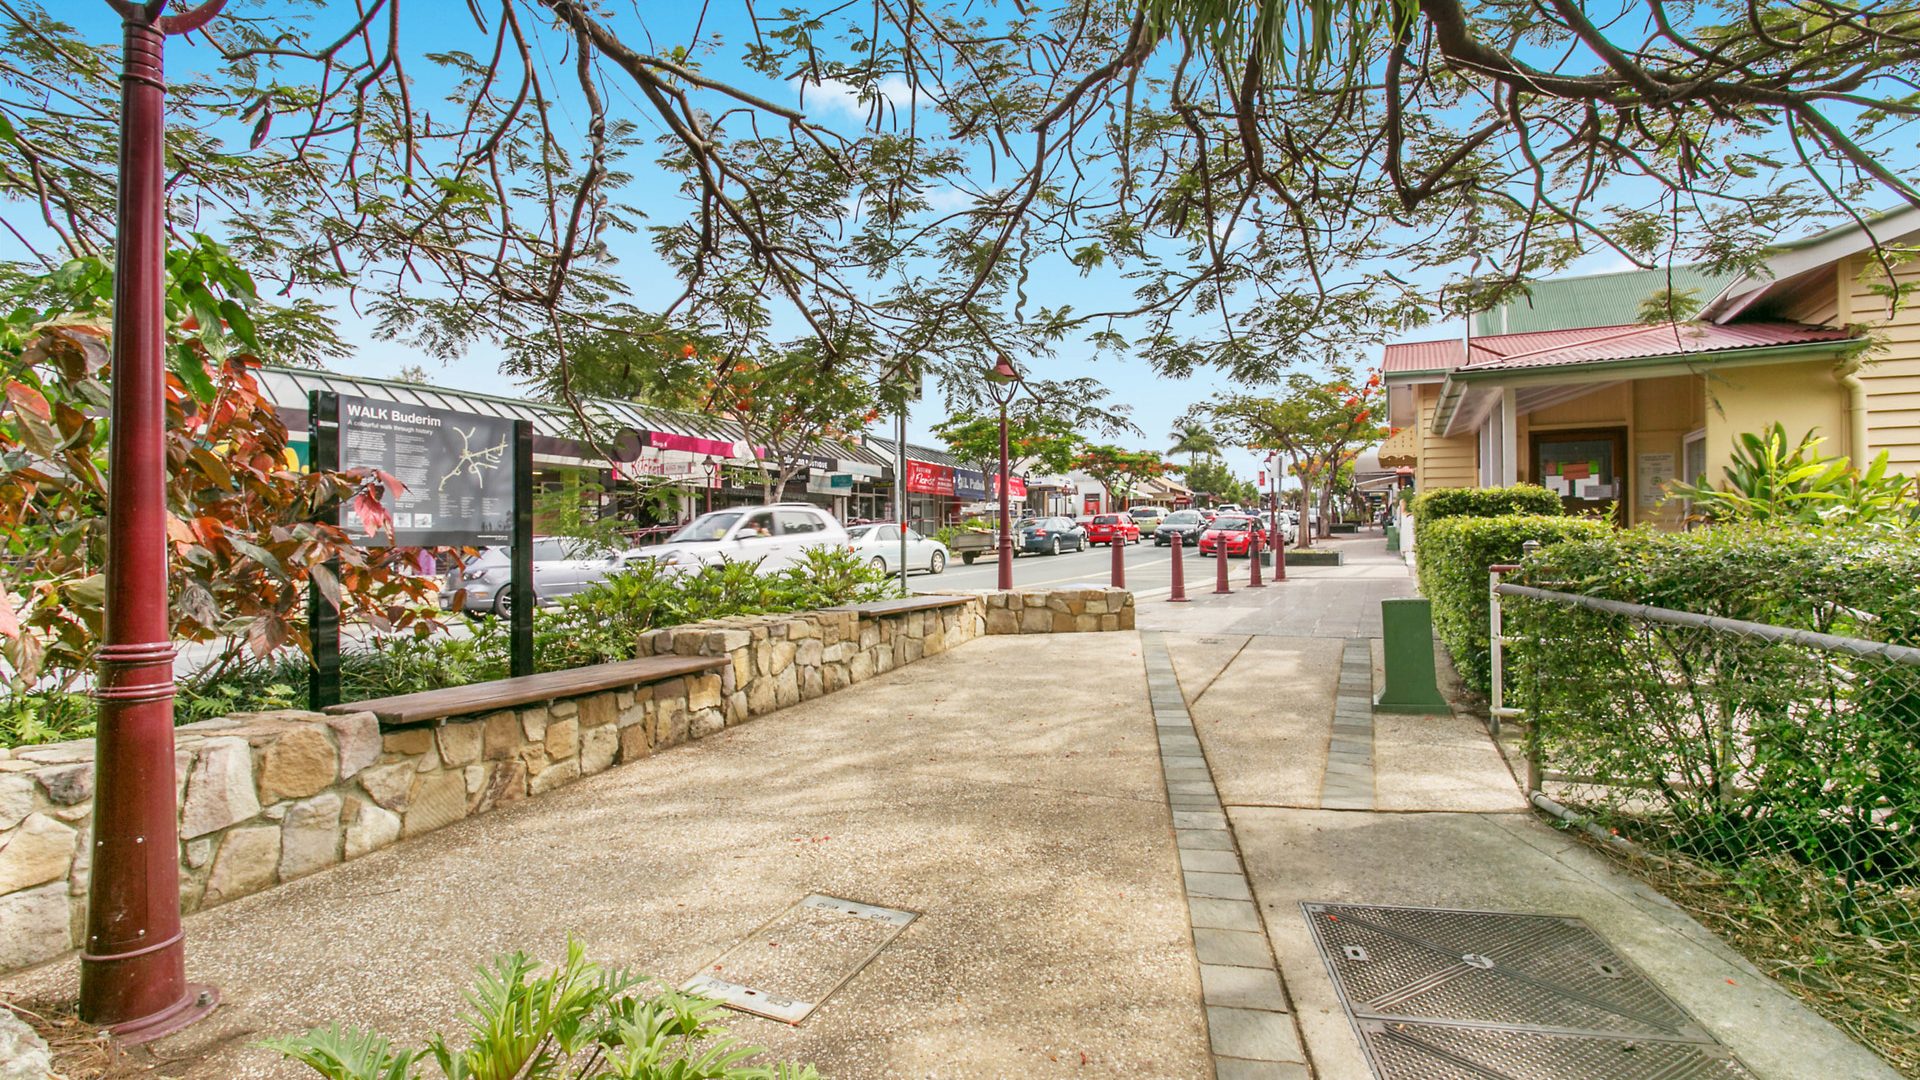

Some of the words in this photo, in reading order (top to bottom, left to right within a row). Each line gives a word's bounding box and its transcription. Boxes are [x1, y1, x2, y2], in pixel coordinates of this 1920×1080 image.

[347, 404, 388, 420] WALK
[391, 410, 441, 427] Buderim
[354, 421, 379, 429] colourful
[394, 425, 415, 434] through
[415, 428, 433, 436] history
